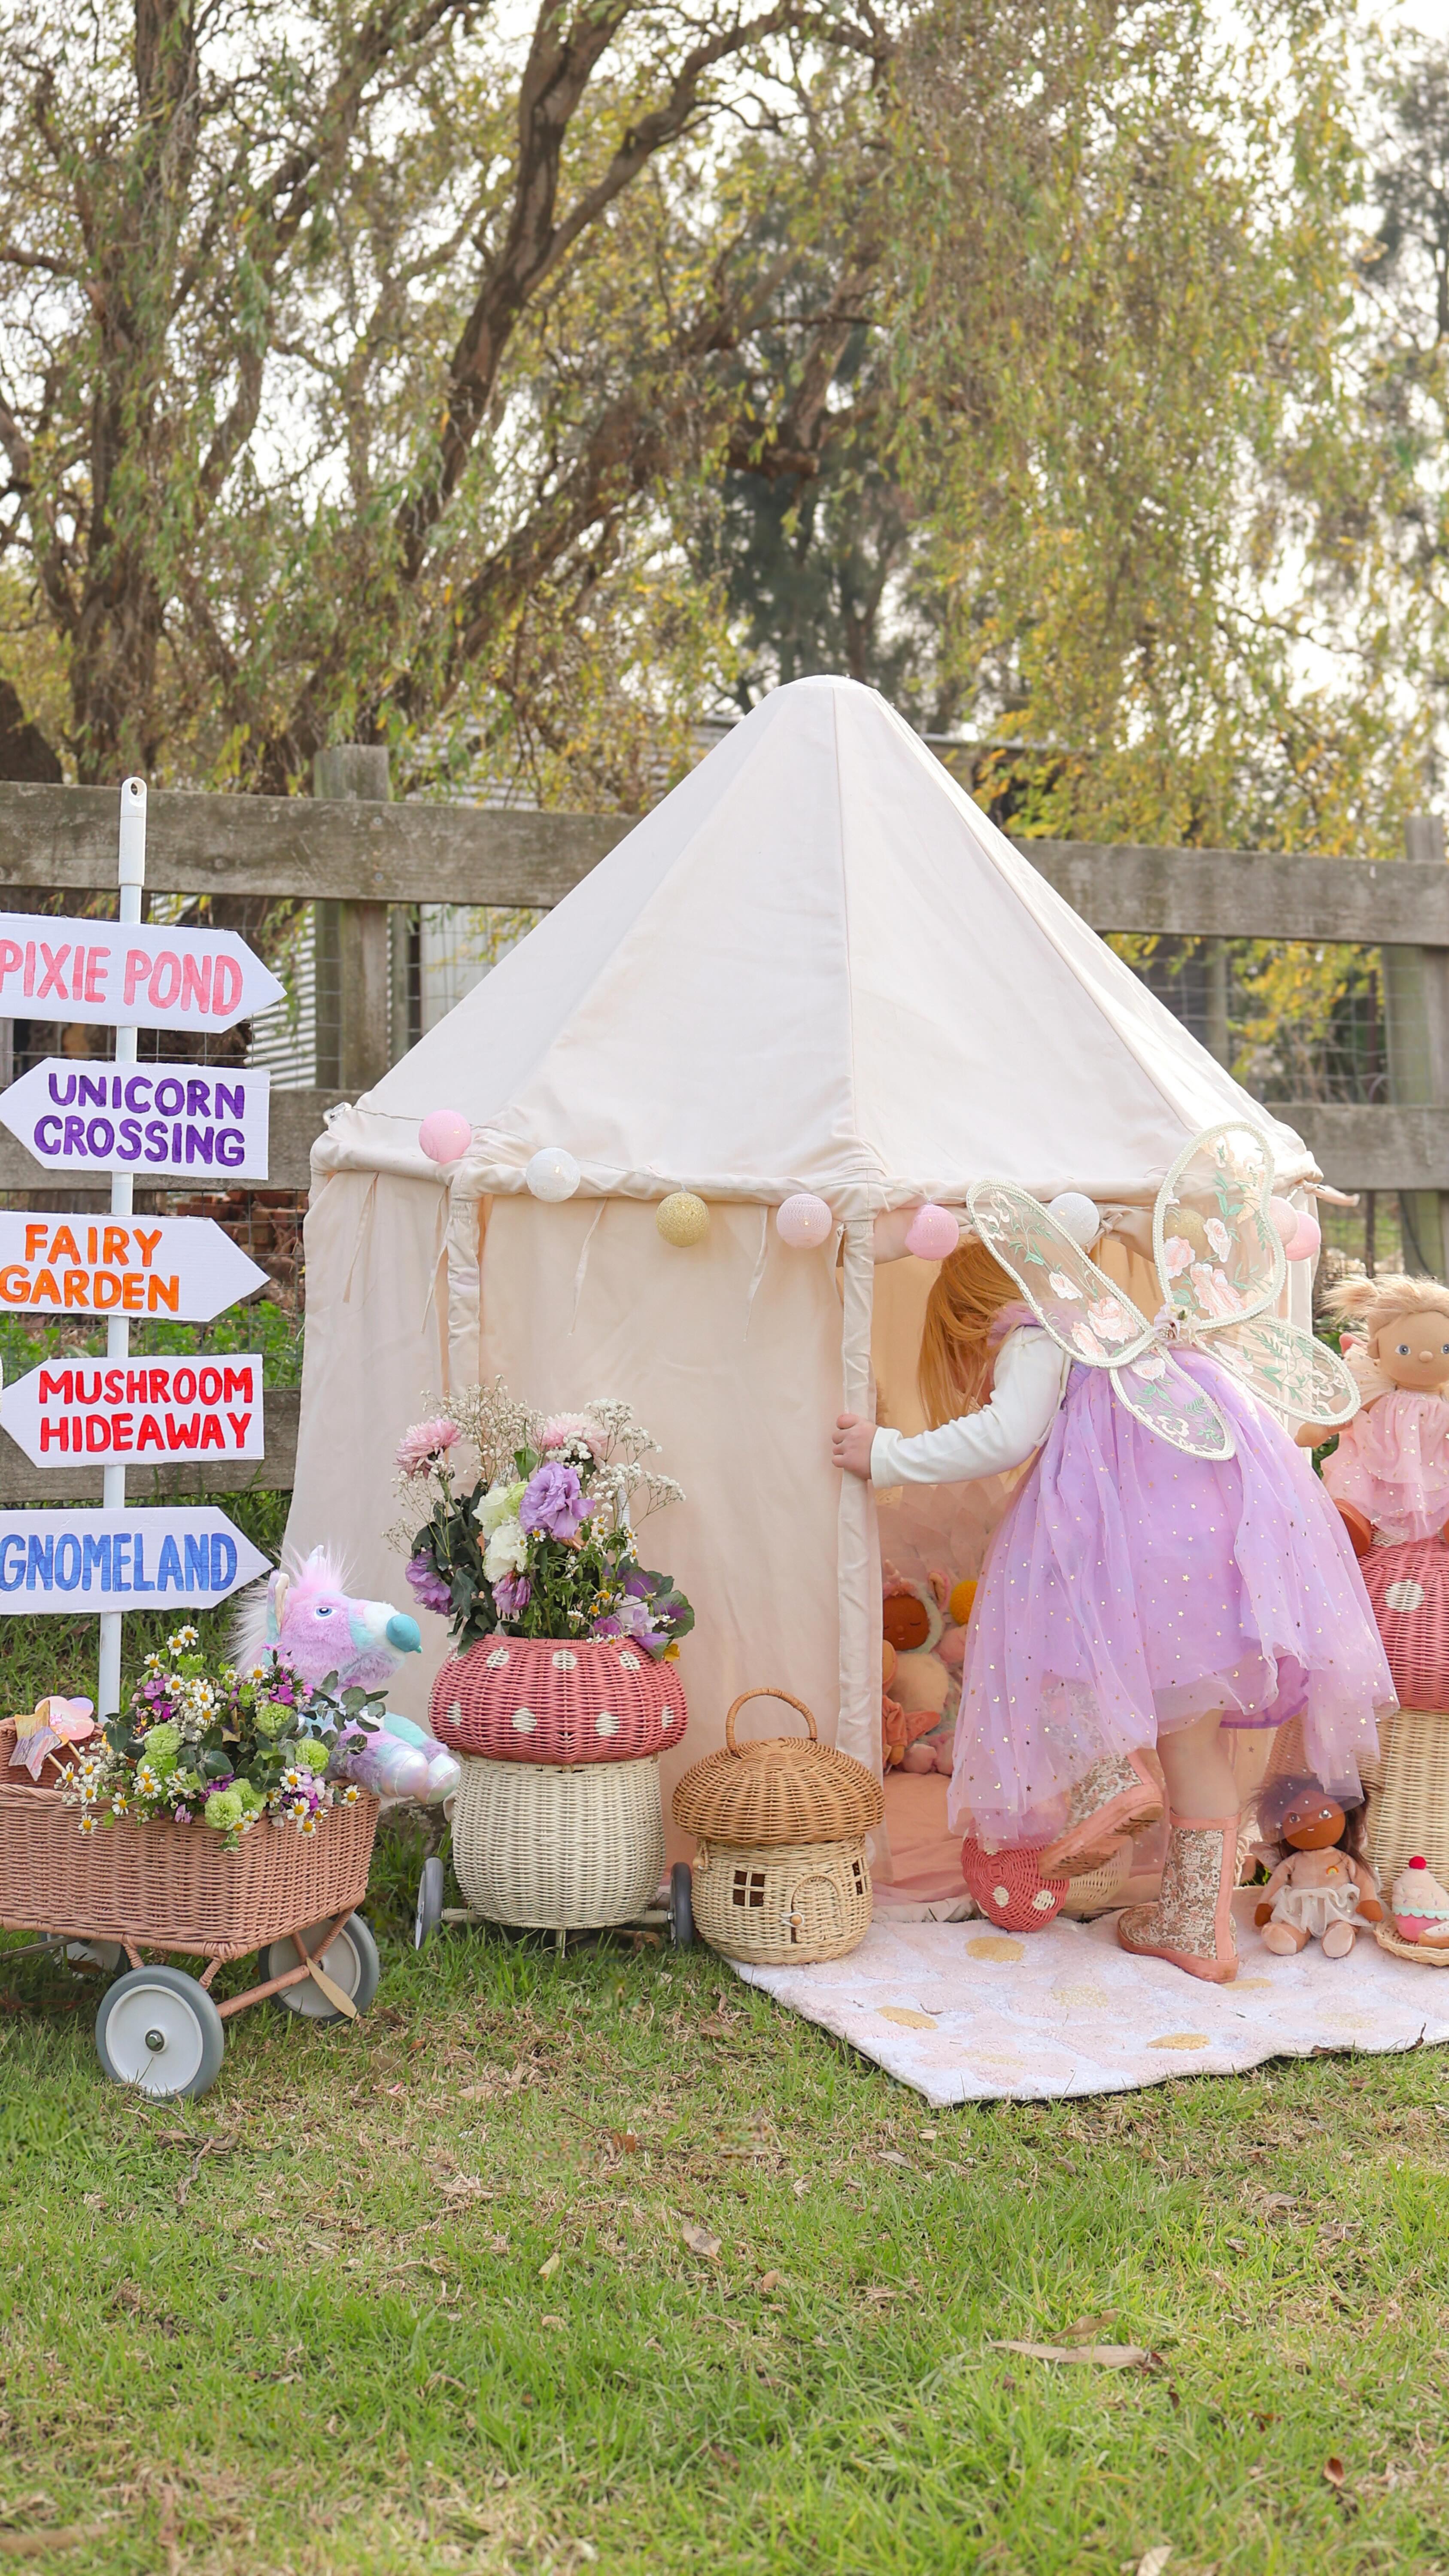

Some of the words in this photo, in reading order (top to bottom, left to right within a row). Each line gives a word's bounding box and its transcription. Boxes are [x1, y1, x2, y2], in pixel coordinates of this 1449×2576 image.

[0, 939, 111, 1003] PIXIE
[123, 949, 243, 1016] POND
[48, 1073, 245, 1119] UNICORN
[33, 1115, 245, 1167] CROSSING
[24, 1224, 162, 1267] FAIRY
[0, 1265, 179, 1312] GARDEN
[39, 1367, 253, 1406] MUSHROOM
[39, 1413, 252, 1452] HIDEAWAY
[0, 1533, 238, 1592] GNOMELAND
